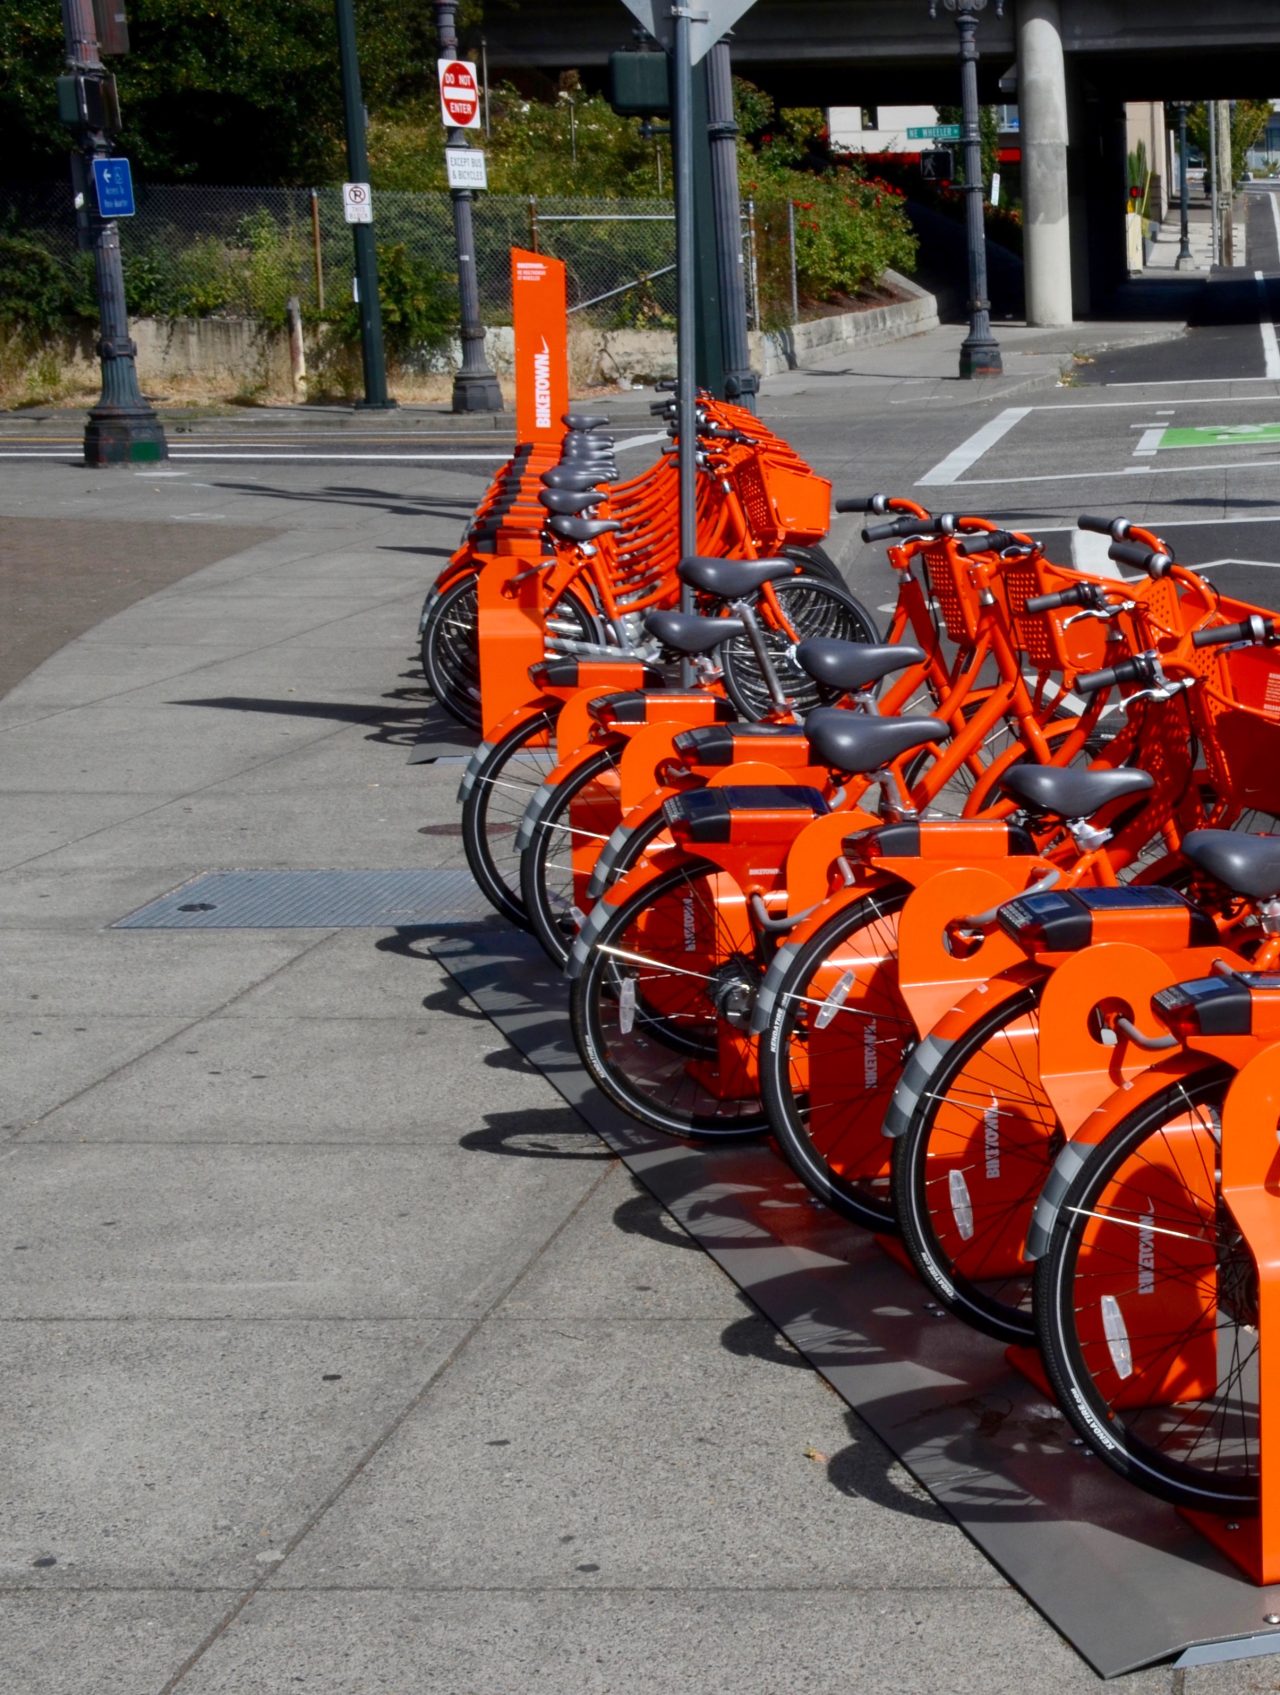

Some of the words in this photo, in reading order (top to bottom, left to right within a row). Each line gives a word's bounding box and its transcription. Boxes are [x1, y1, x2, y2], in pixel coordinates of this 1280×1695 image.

[445, 73, 455, 84] DO
[458, 75, 471, 86] NOT
[449, 102, 472, 115] ENTER
[450, 156, 470, 168] EXCEPT
[909, 129, 918, 138] NE
[922, 127, 952, 137] WHEELER
[534, 353, 551, 428] BIKETOWN
[864, 1025, 878, 1089] BIKETOWN
[984, 1107, 1000, 1179] BIKETOWN
[1138, 1214, 1154, 1294] BIKETOWN
[1071, 1387, 1116, 1450] KENDATIRE.COM
